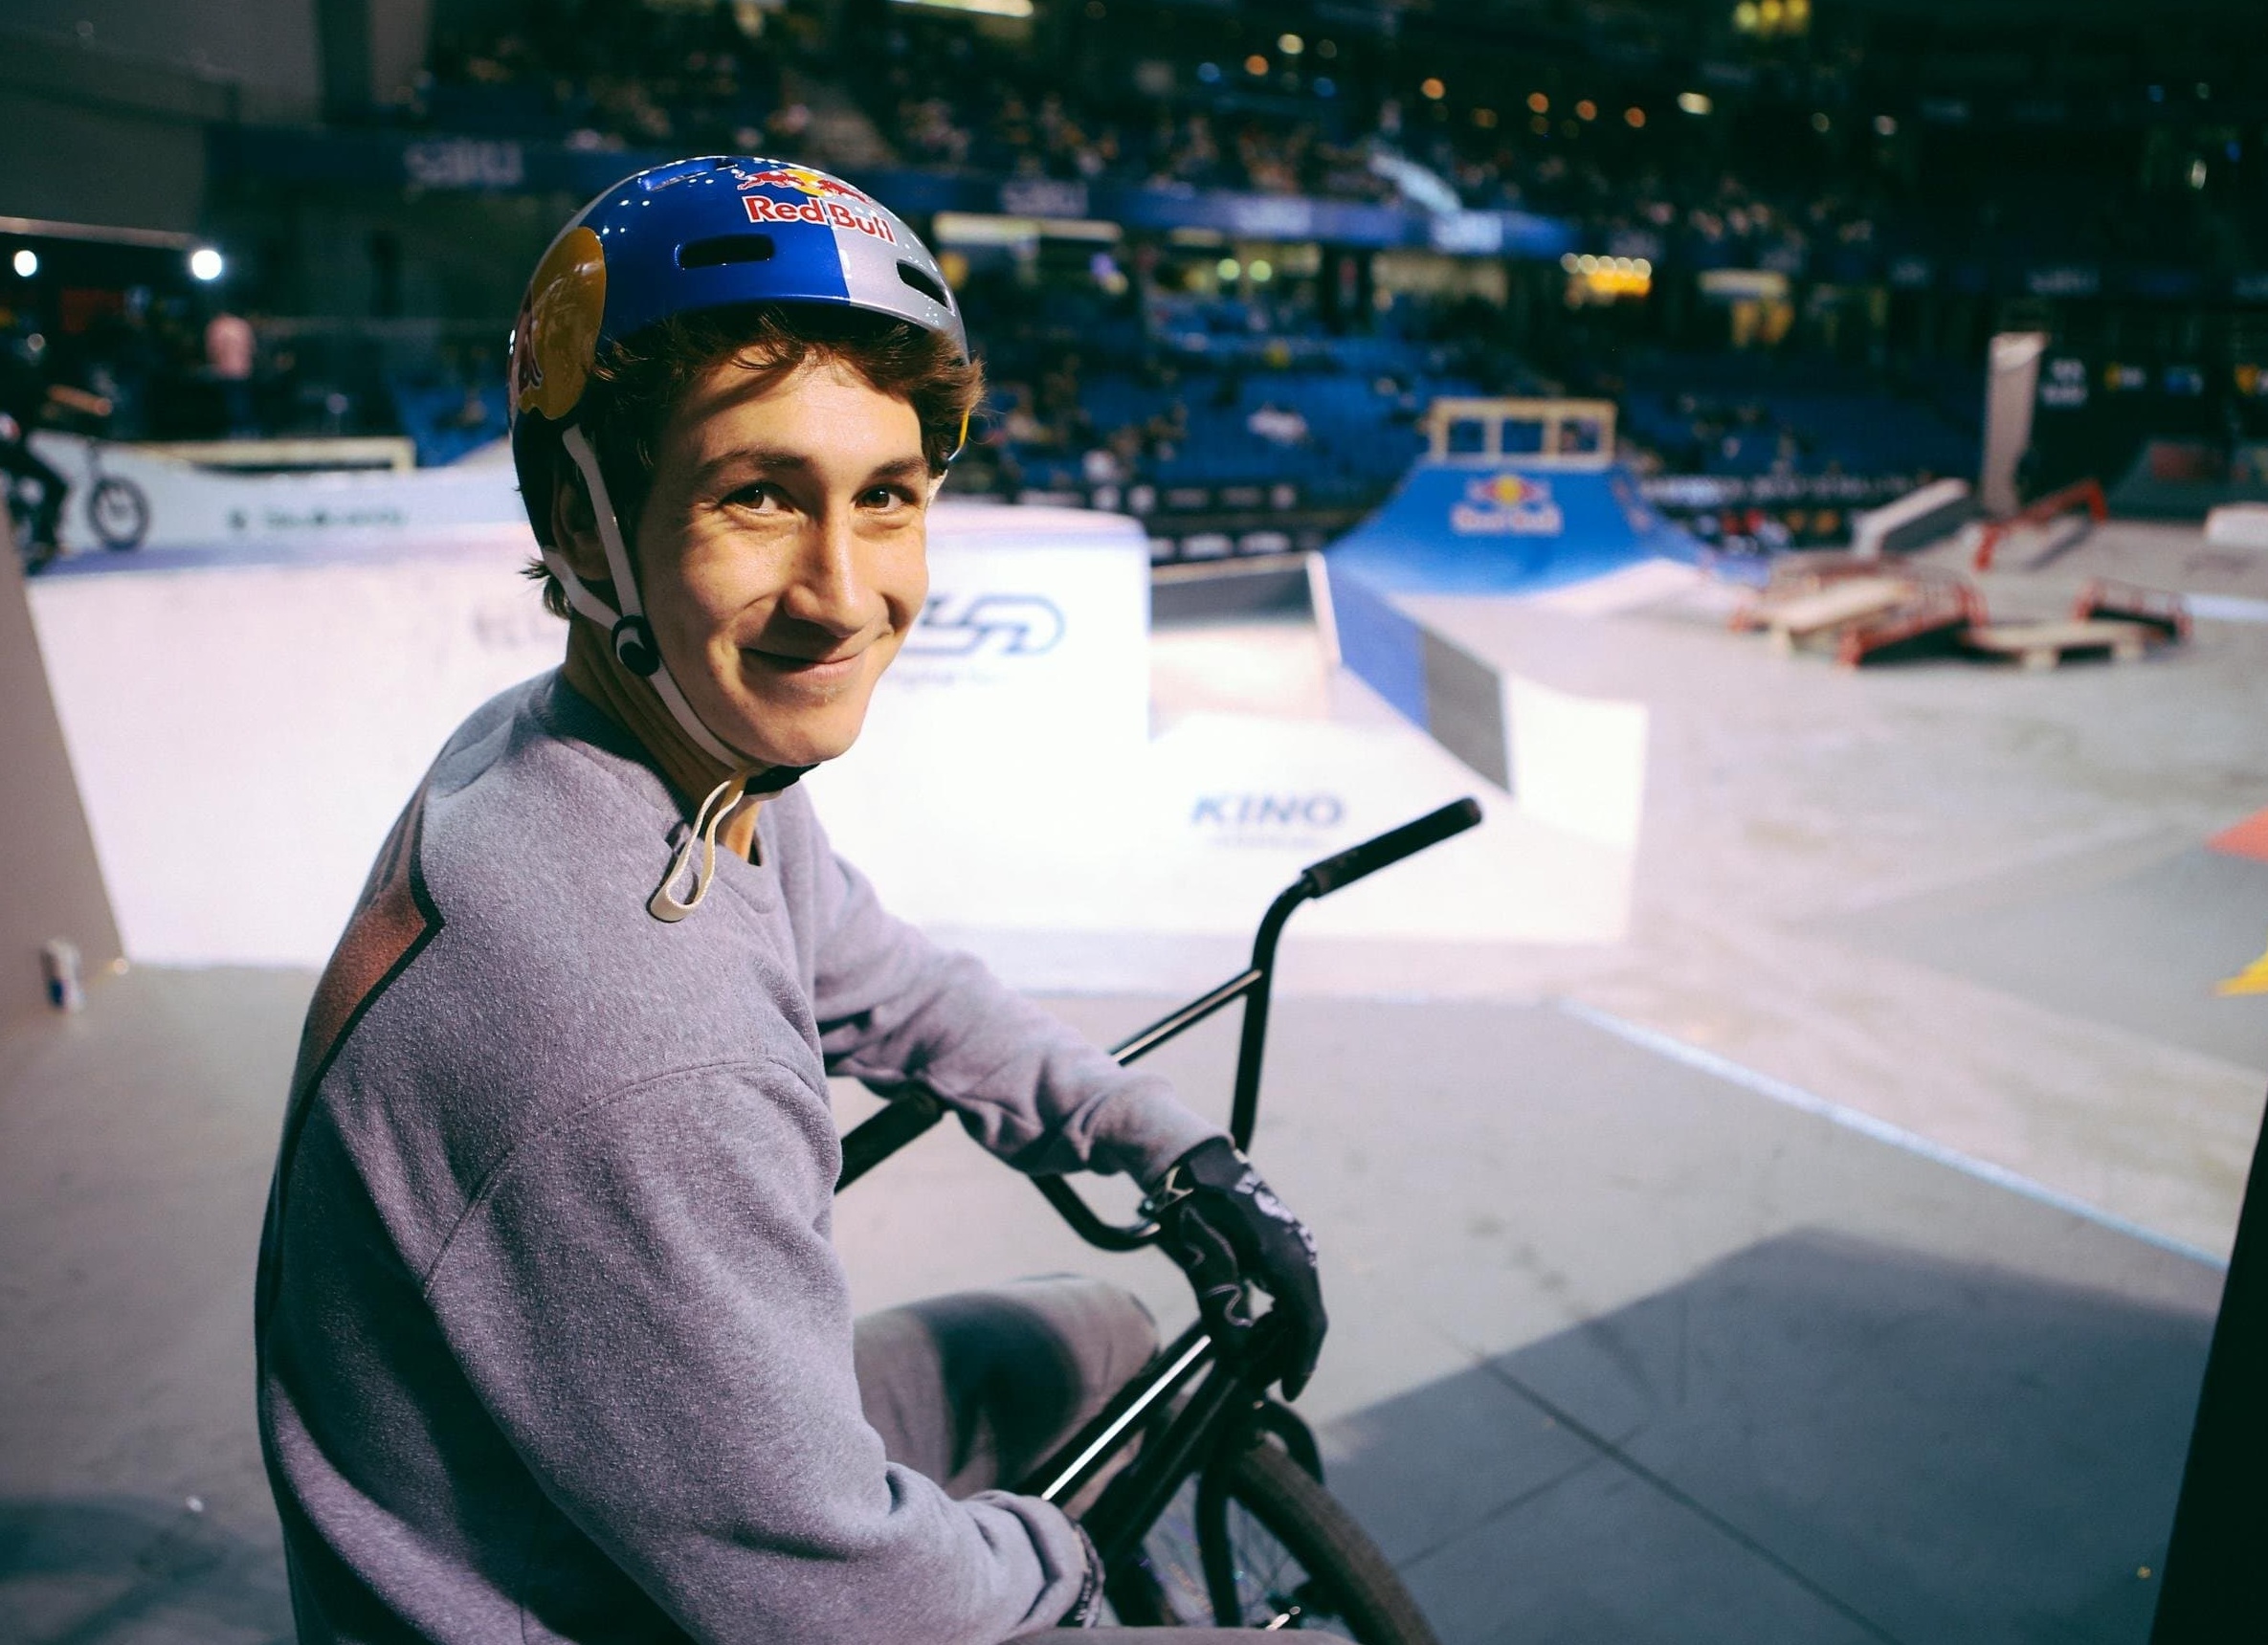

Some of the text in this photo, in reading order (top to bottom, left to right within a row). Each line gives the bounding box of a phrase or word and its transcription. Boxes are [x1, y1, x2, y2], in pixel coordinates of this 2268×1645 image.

[743, 195, 896, 245] Red Bull
[1191, 793, 1347, 828] KINO
